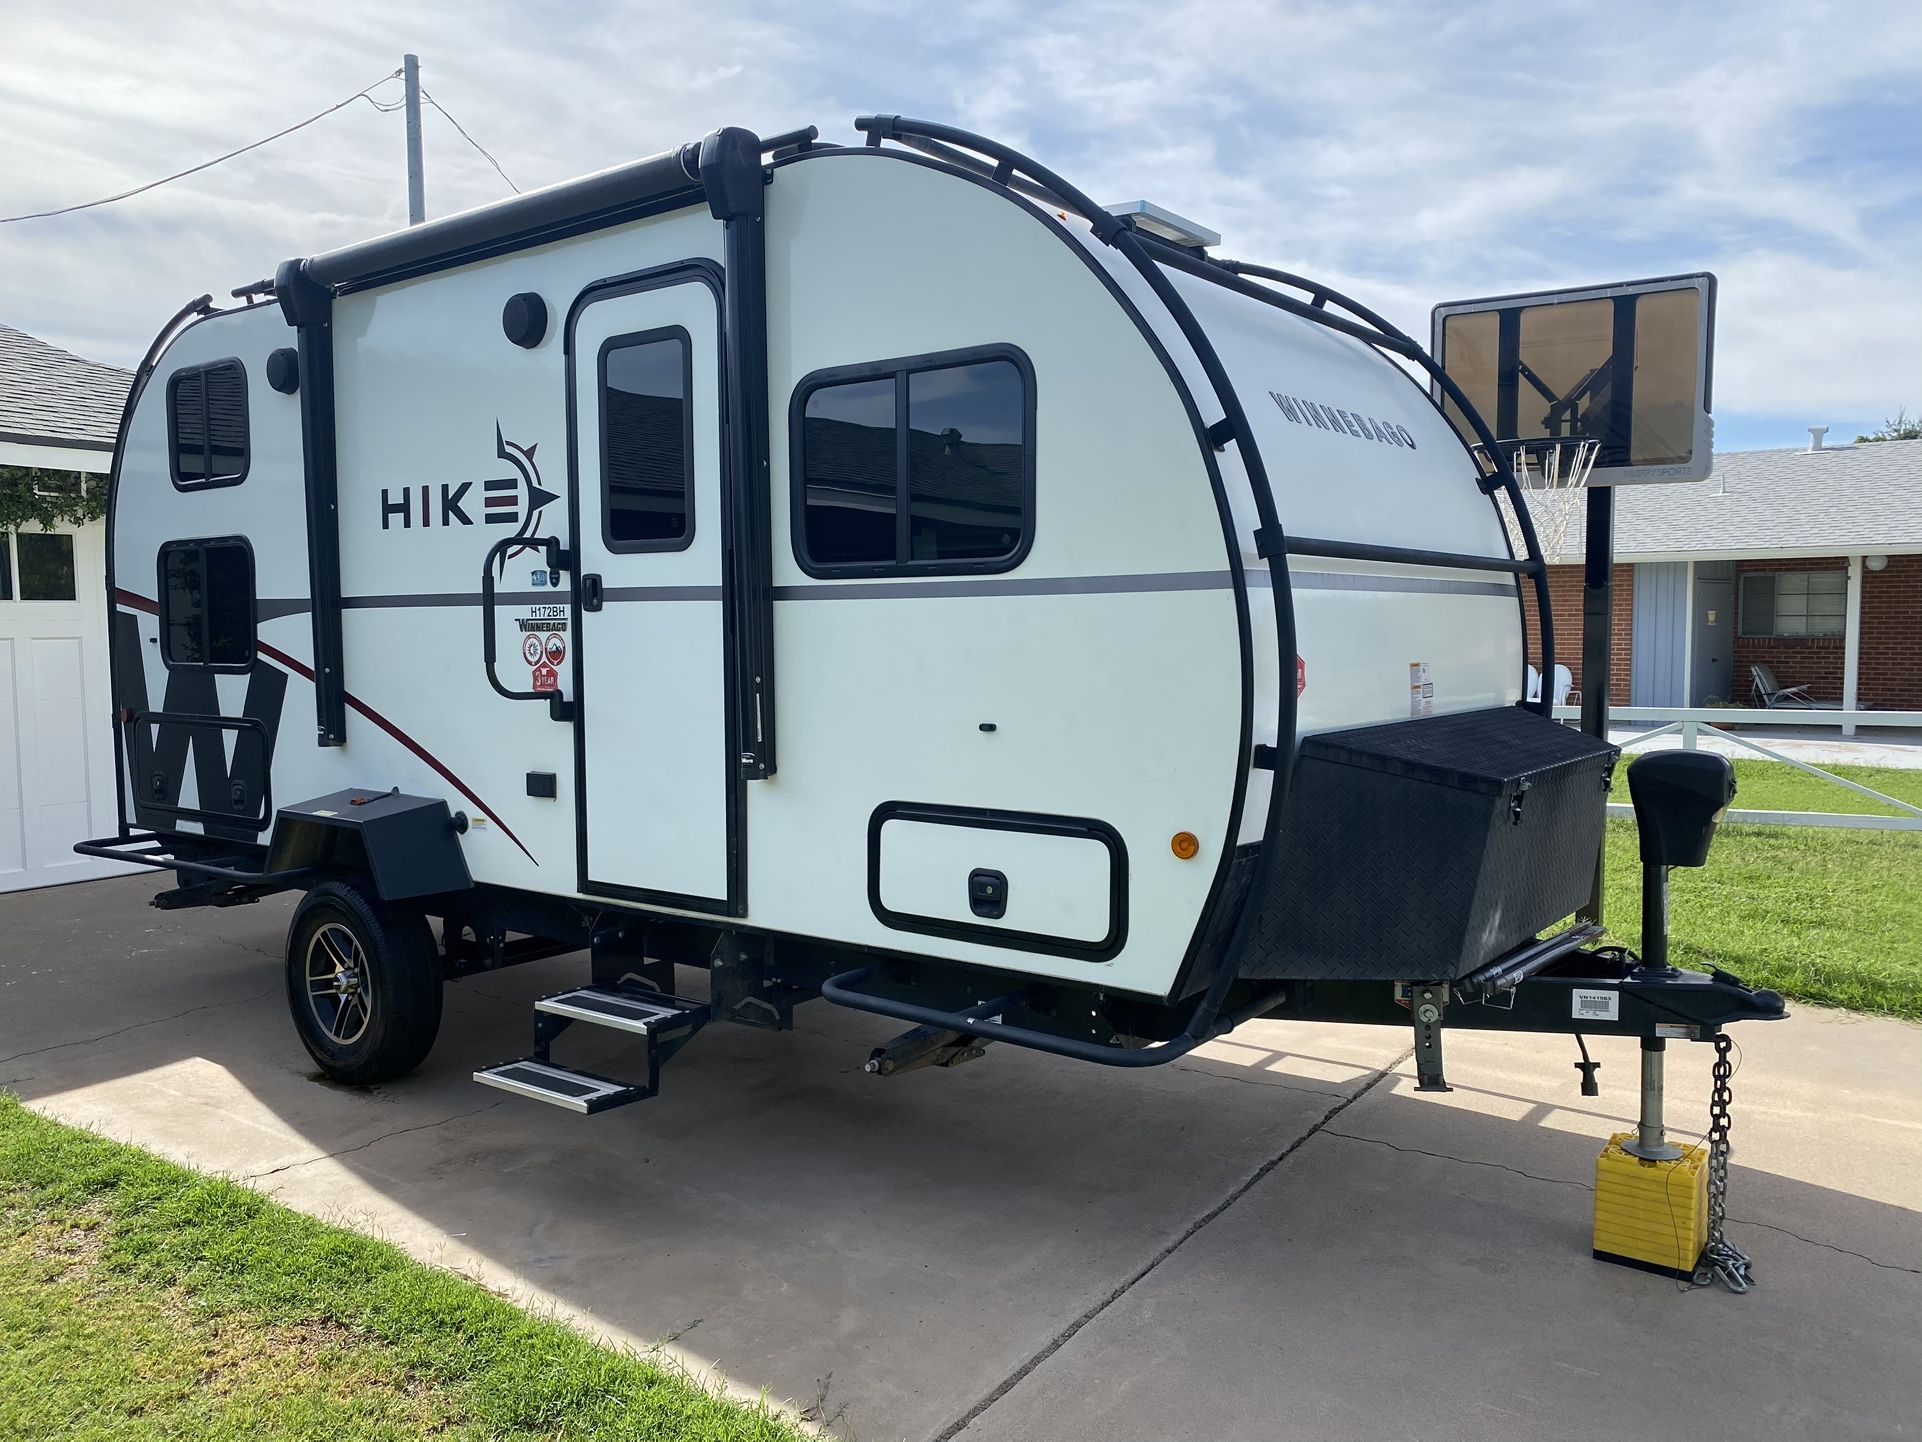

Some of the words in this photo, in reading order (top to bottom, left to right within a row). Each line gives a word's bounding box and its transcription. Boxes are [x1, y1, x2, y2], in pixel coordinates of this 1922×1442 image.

[1268, 390, 1417, 451] WINNEBAGO
[380, 477, 520, 531] HIKE
[530, 605, 566, 618] H172BH
[514, 617, 569, 633] WINNEBAGO
[535, 671, 542, 686] 3
